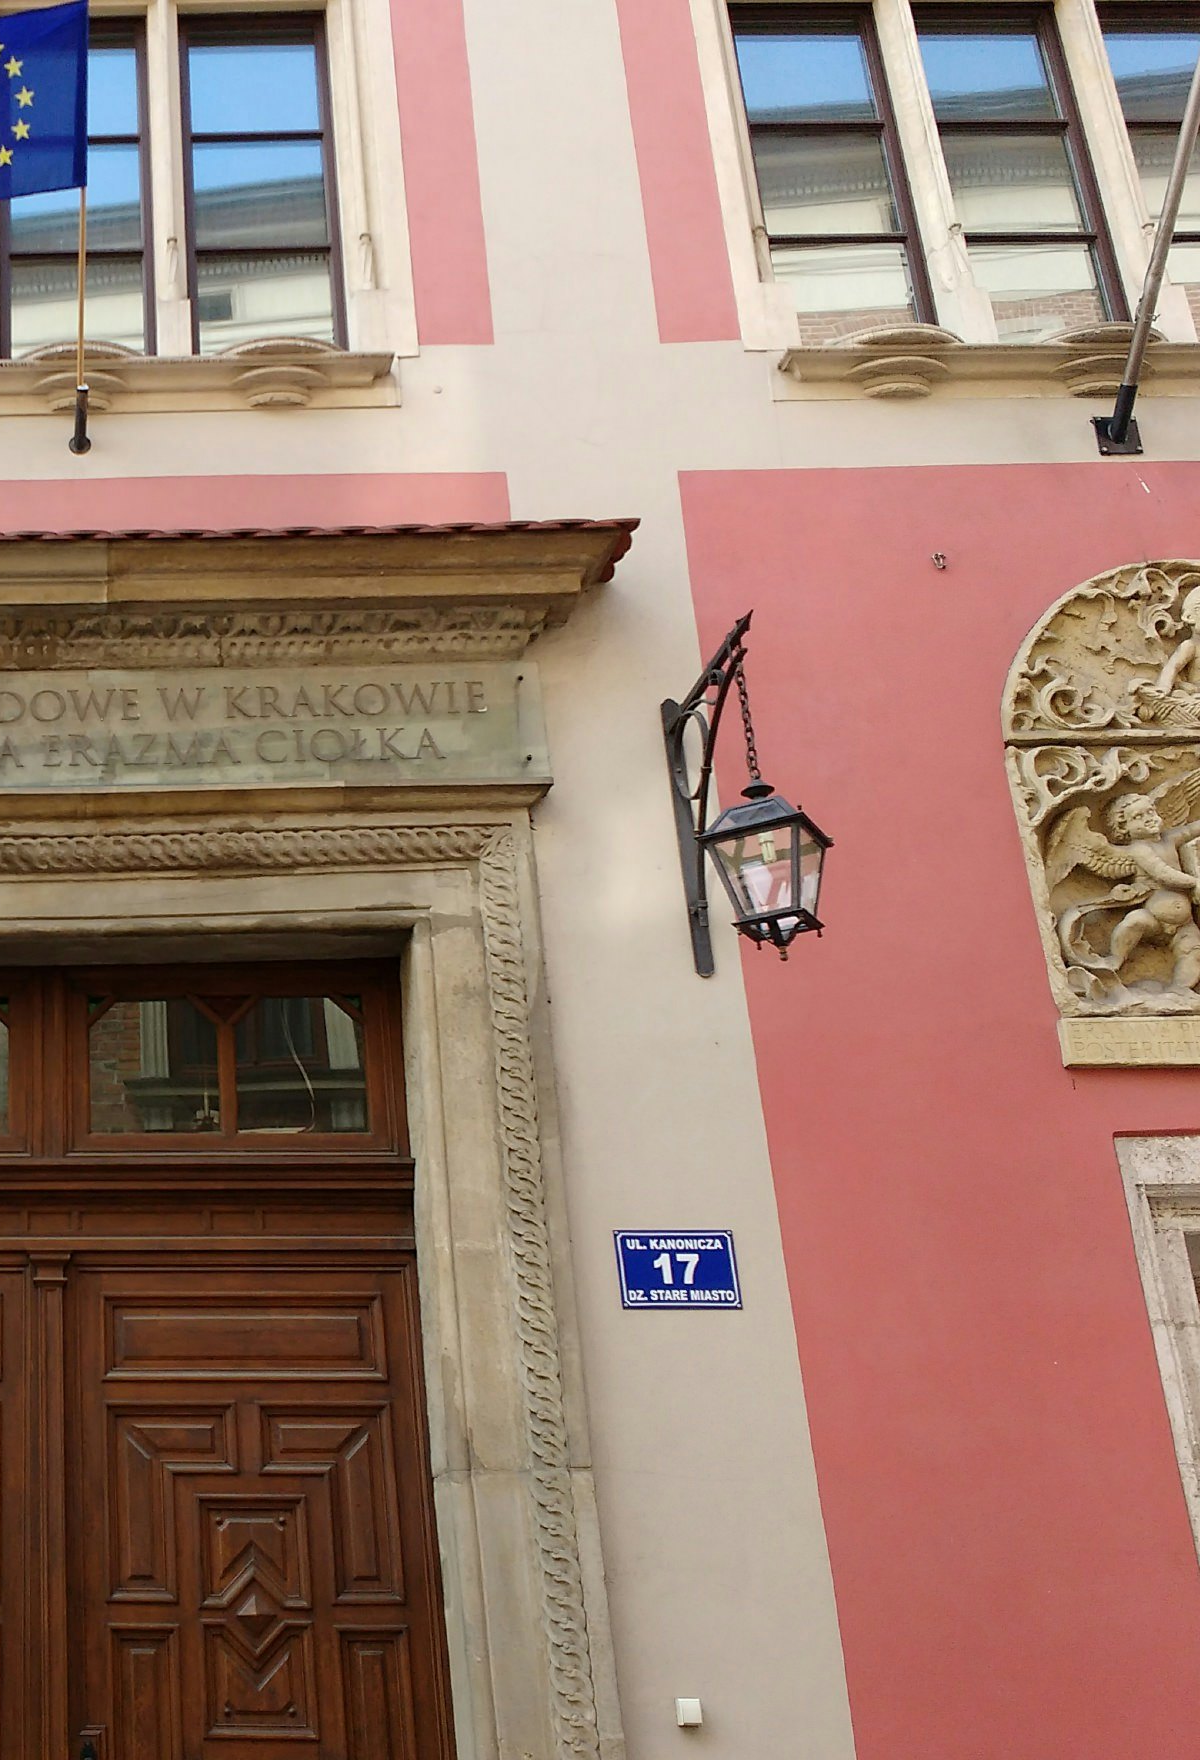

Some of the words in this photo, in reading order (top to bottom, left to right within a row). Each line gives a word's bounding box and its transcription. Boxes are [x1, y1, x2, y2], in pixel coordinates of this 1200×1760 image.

[154, 686, 207, 721] W
[223, 680, 489, 719] KRAKOWIE
[41, 731, 243, 768] ERAZMA
[255, 727, 448, 764] CIOŁKA
[625, 1238, 647, 1250] UL.
[650, 1238, 724, 1250] KANONICZA
[653, 1252, 700, 1285] 17
[628, 1289, 648, 1301] DZ.
[650, 1289, 688, 1301] STARE
[690, 1289, 735, 1301] MIASTO
